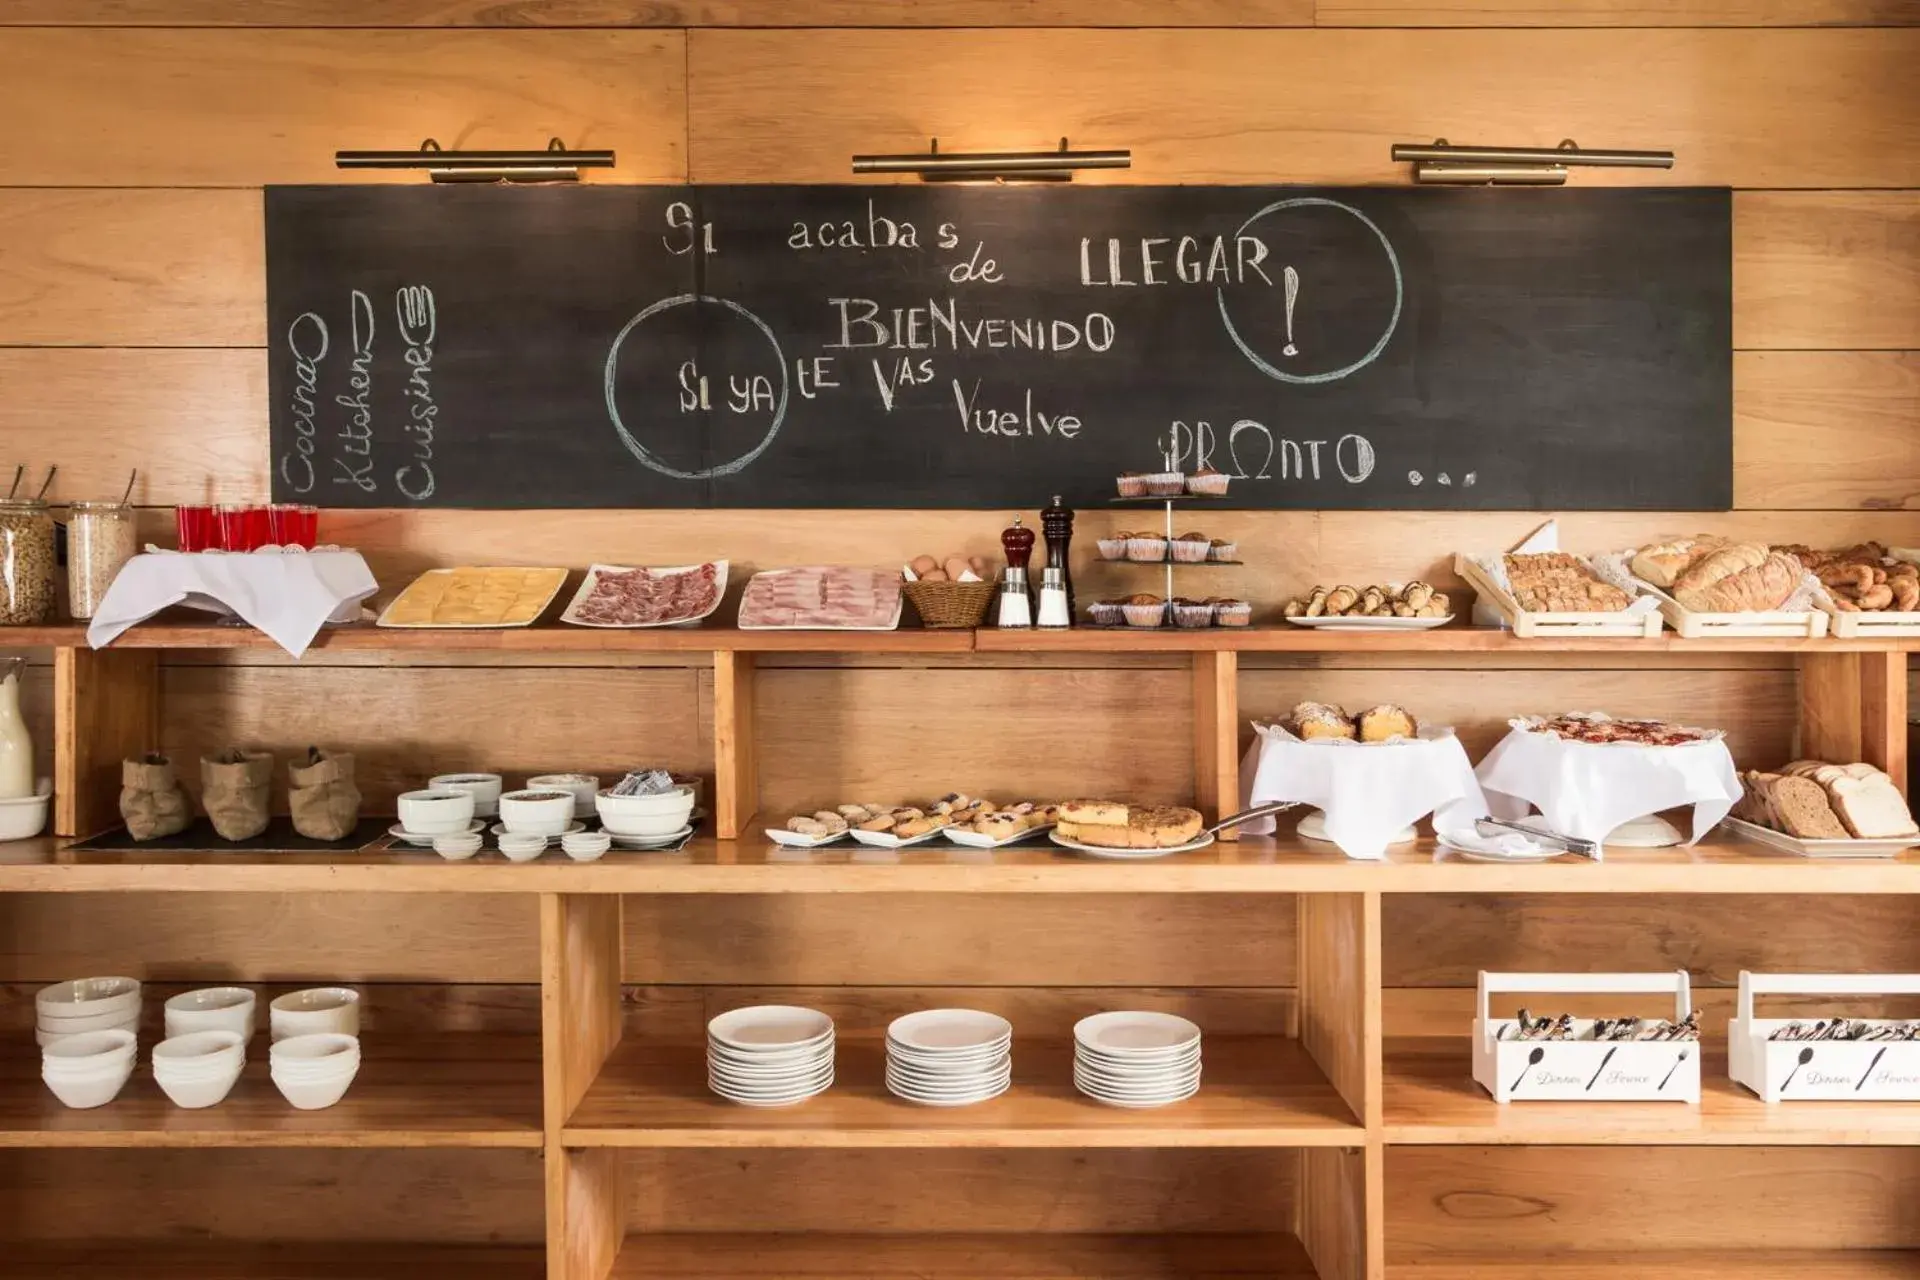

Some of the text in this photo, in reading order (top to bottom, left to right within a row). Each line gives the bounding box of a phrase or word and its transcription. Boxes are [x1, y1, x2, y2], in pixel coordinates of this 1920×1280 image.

[787, 197, 960, 249] acabas
[948, 240, 1004, 284] de
[1079, 235, 1274, 287] LLEGAR
[821, 297, 1116, 353] BIENVENIDO
[281, 354, 319, 493] Cocina
[332, 348, 378, 493] Kitchen
[394, 344, 440, 501] Cuisine
[951, 377, 1084, 439] Vuelve
